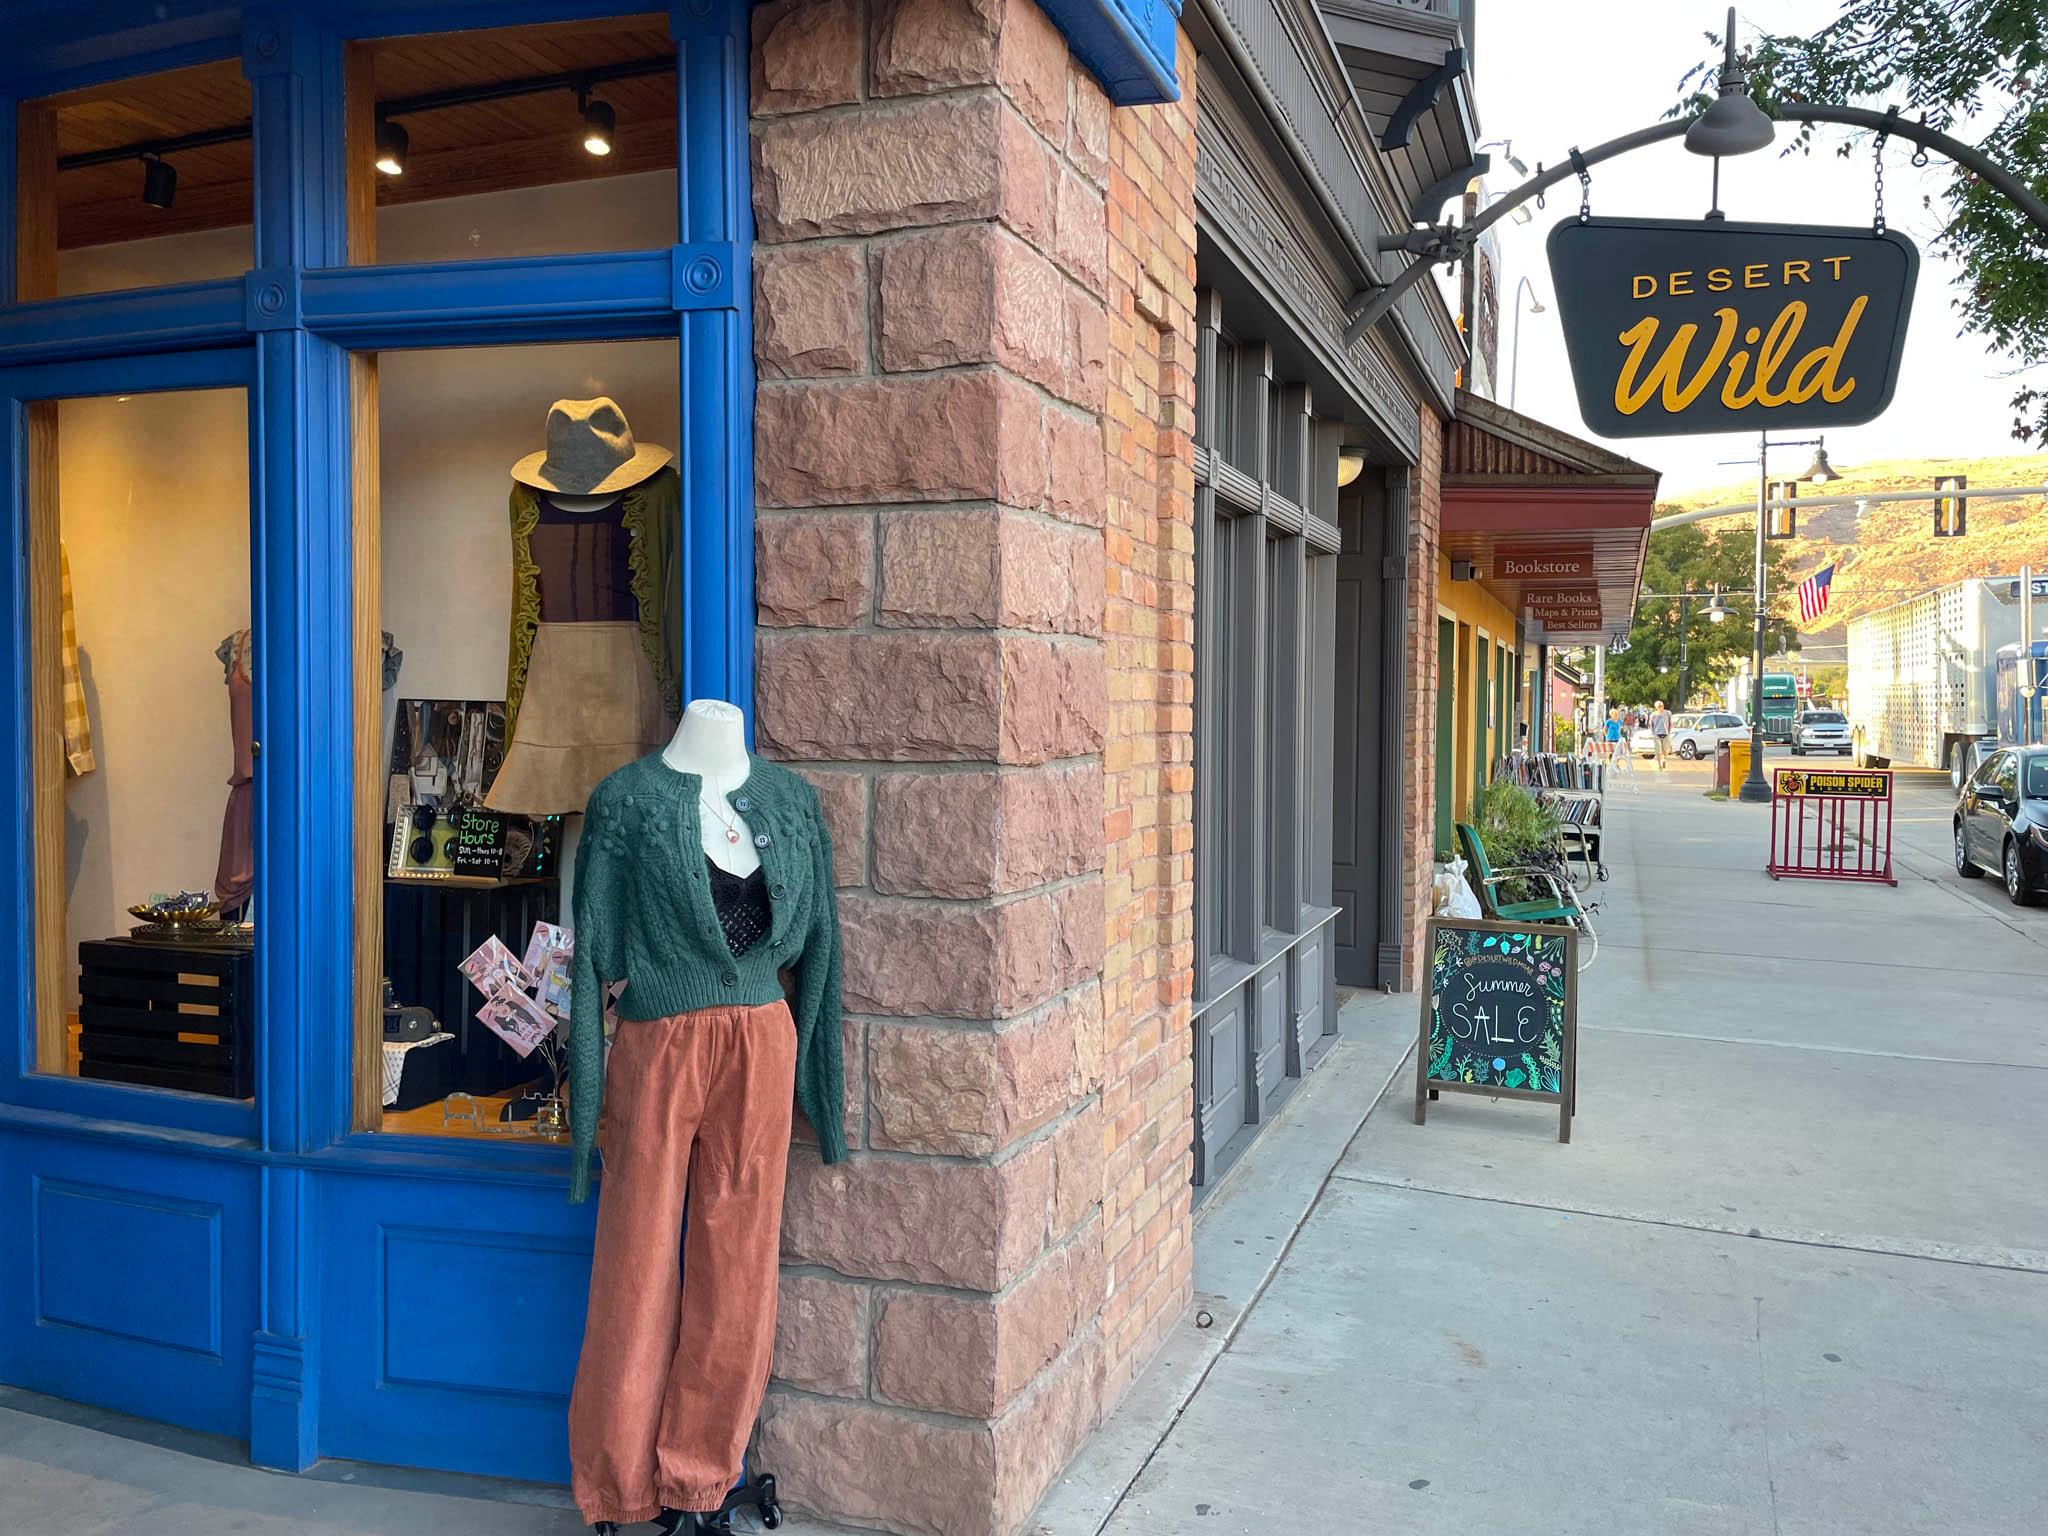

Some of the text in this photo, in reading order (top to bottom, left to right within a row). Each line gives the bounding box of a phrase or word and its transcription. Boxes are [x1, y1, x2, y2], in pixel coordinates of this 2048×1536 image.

[1632, 256, 1851, 299] DESERT
[1614, 295, 1869, 416] Wild
[1505, 560, 1580, 574] Bookstore
[1527, 592, 1592, 604] Rare Books
[1535, 607, 1599, 619] Maps & Prints
[1547, 620, 1597, 629] Best Sellers
[1810, 775, 1883, 788] POISON SPIDER
[461, 813, 499, 833] Store
[459, 830, 494, 845] Hours
[1463, 972, 1534, 1001] Summer
[1451, 1003, 1537, 1045] SALE
